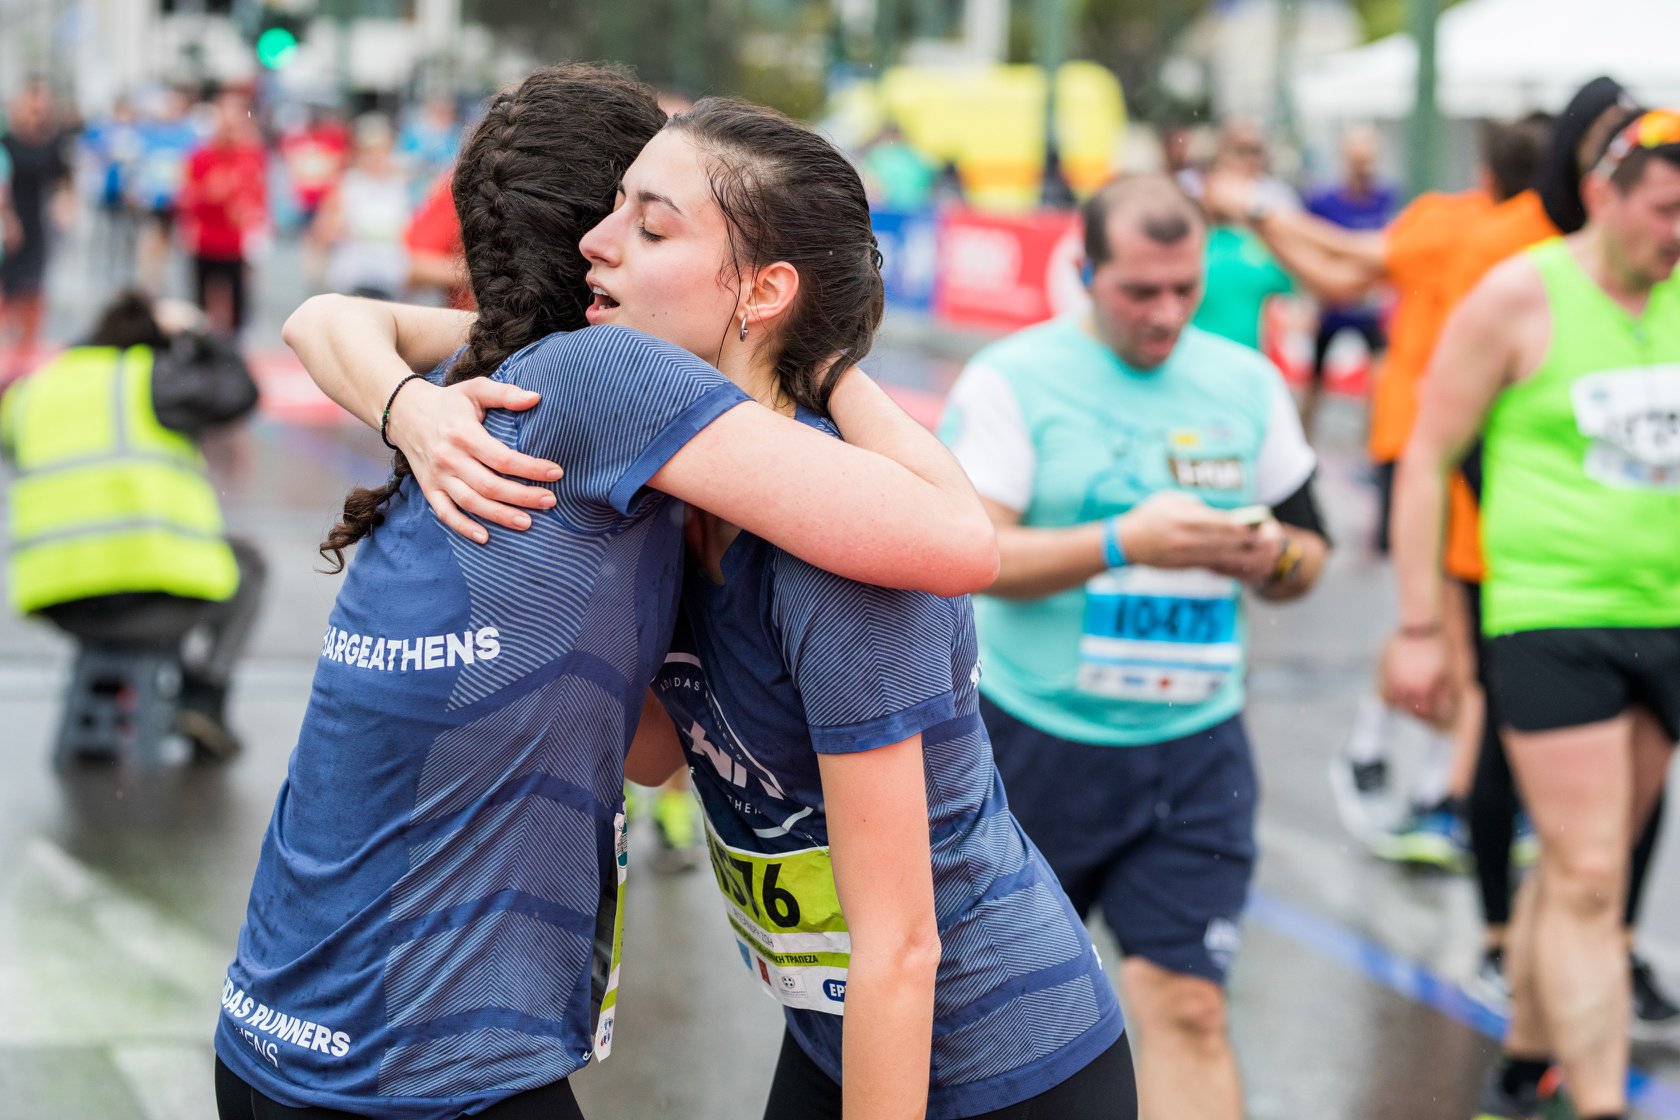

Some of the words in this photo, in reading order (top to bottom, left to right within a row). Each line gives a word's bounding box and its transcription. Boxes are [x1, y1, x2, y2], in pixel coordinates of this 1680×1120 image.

[785, 954, 819, 964] ΤΡΑΠΕΖΑ
[829, 983, 846, 998] ΕΡ
[245, 1003, 351, 1057] RUNNERS
